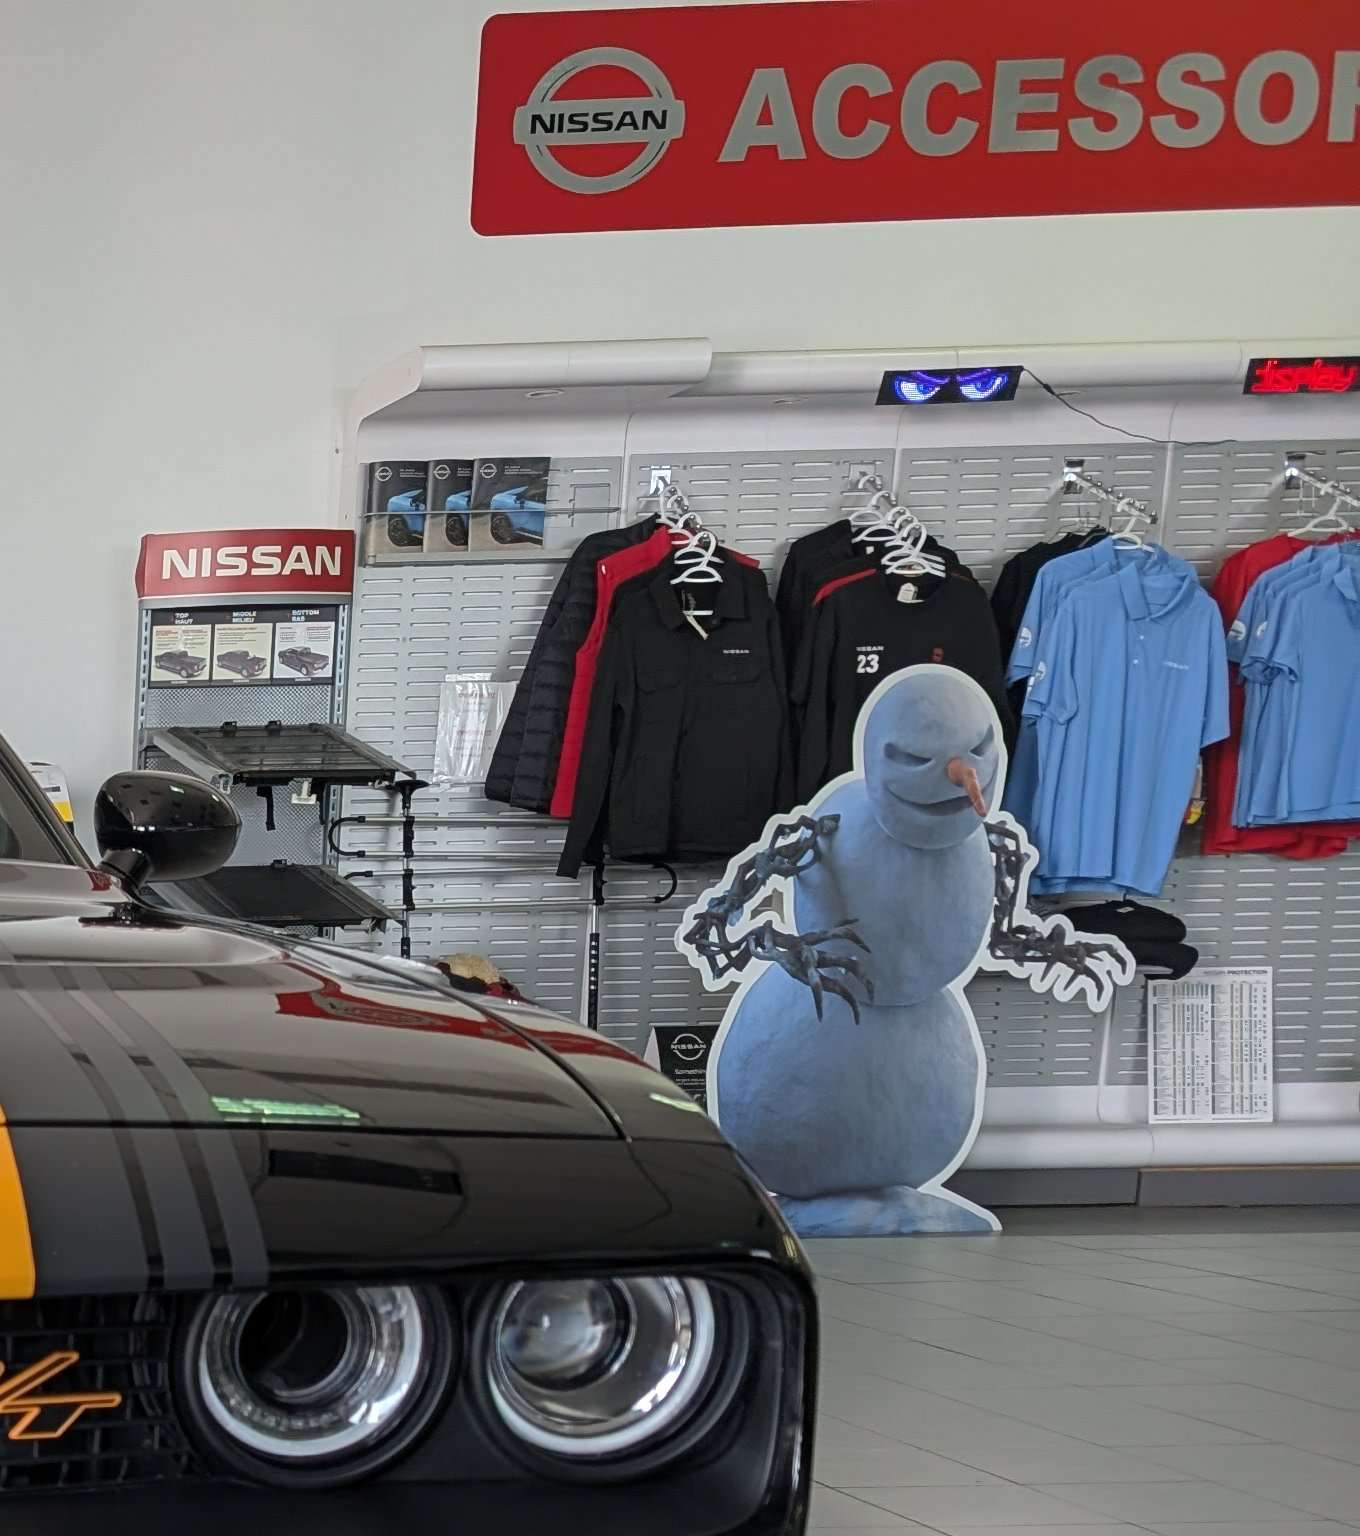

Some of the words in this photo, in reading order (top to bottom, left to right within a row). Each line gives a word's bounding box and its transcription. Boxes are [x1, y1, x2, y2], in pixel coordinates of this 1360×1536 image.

[529, 106, 669, 136] NISSAN
[161, 544, 342, 580] NISSAN
[856, 654, 880, 674] 23
